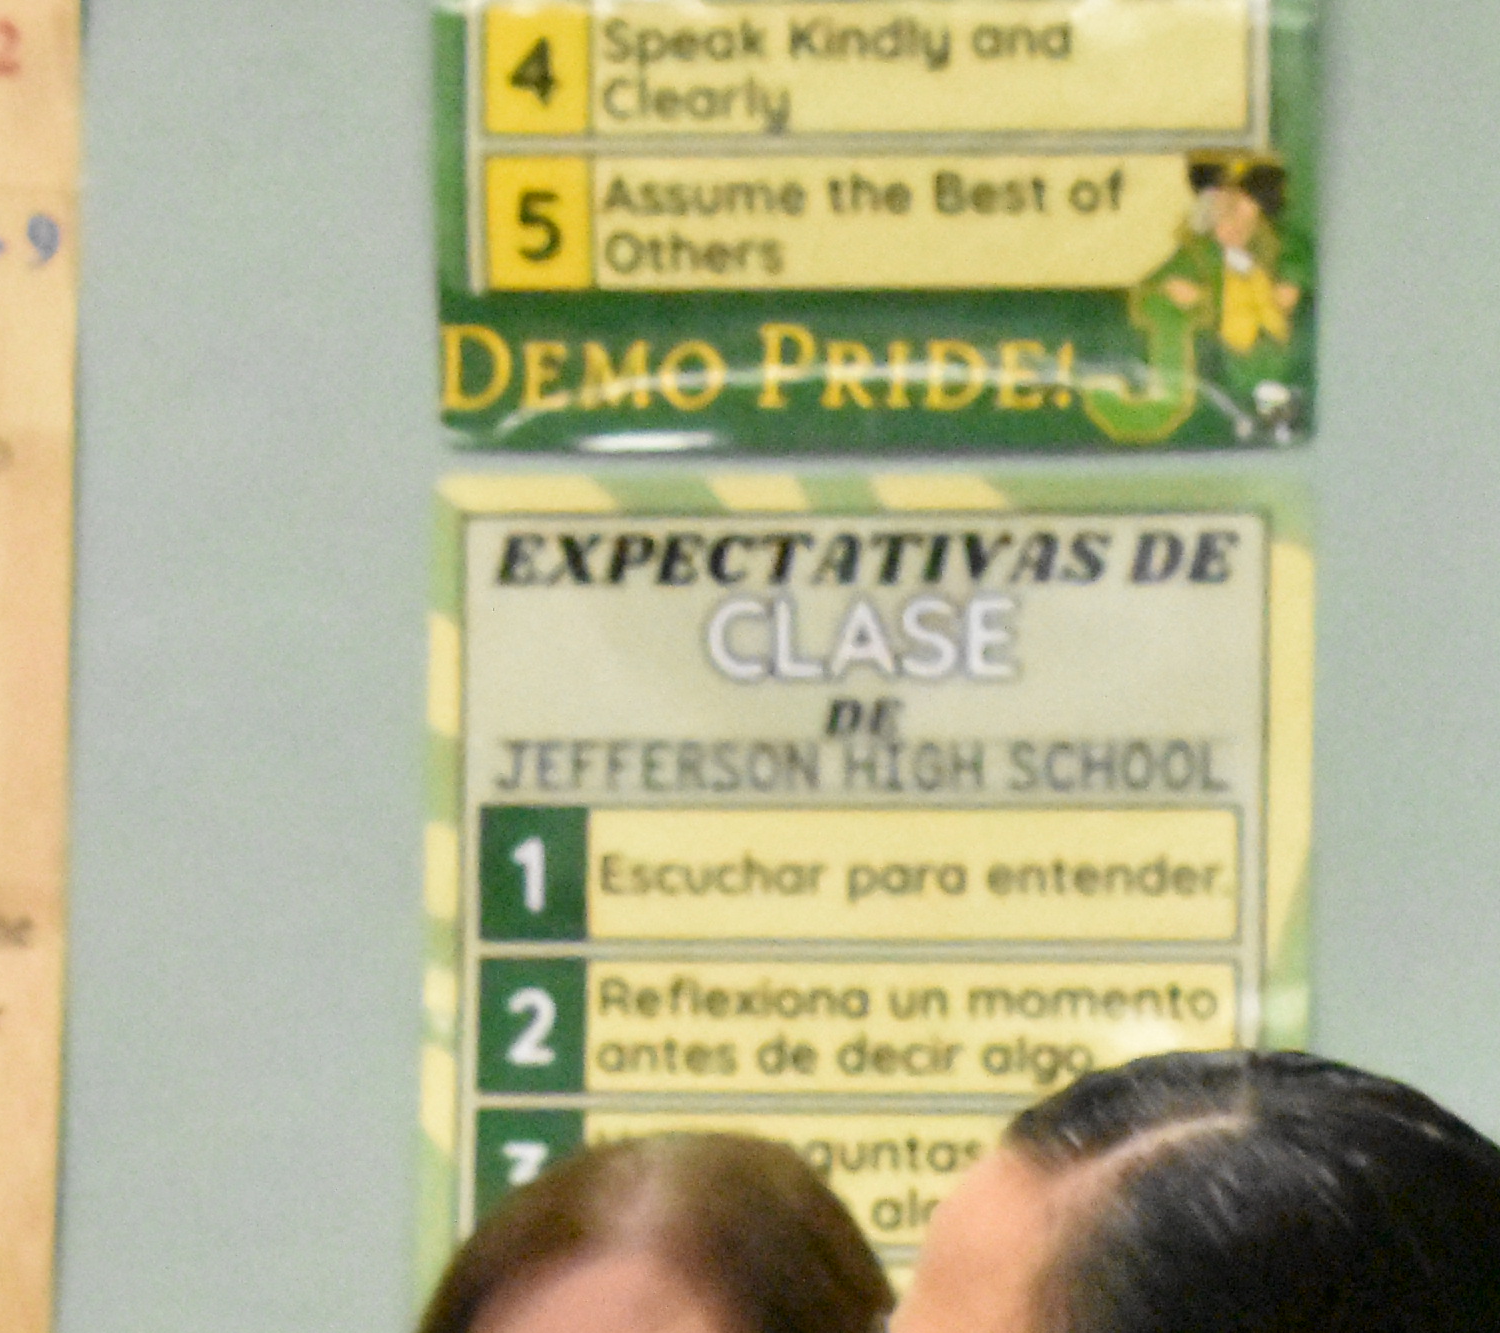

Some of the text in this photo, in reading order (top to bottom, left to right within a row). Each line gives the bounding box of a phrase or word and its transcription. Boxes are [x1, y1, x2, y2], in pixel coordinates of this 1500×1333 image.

[507, 38, 558, 105] 4
[603, 17, 1074, 72] Speak Kindly and
[602, 77, 791, 134] Clearly
[602, 172, 807, 217] Assume
[827, 172, 911, 216] the
[933, 173, 1047, 216] Best
[516, 191, 563, 262] 5
[603, 233, 785, 275] Others
[499, 531, 1113, 586] EXPECTATIVAS
[705, 597, 1018, 681] CLASE
[496, 739, 1230, 794] JEFFERSON HIGH SCHOOL
[511, 838, 546, 912] 1
[600, 855, 824, 895] Escuchar
[847, 861, 966, 903] para
[507, 988, 557, 1067] 2
[597, 978, 1219, 1022] Reflexiona un momento
[596, 1038, 736, 1077] antes
[758, 1034, 818, 1075] de
[836, 1034, 960, 1075] decir
